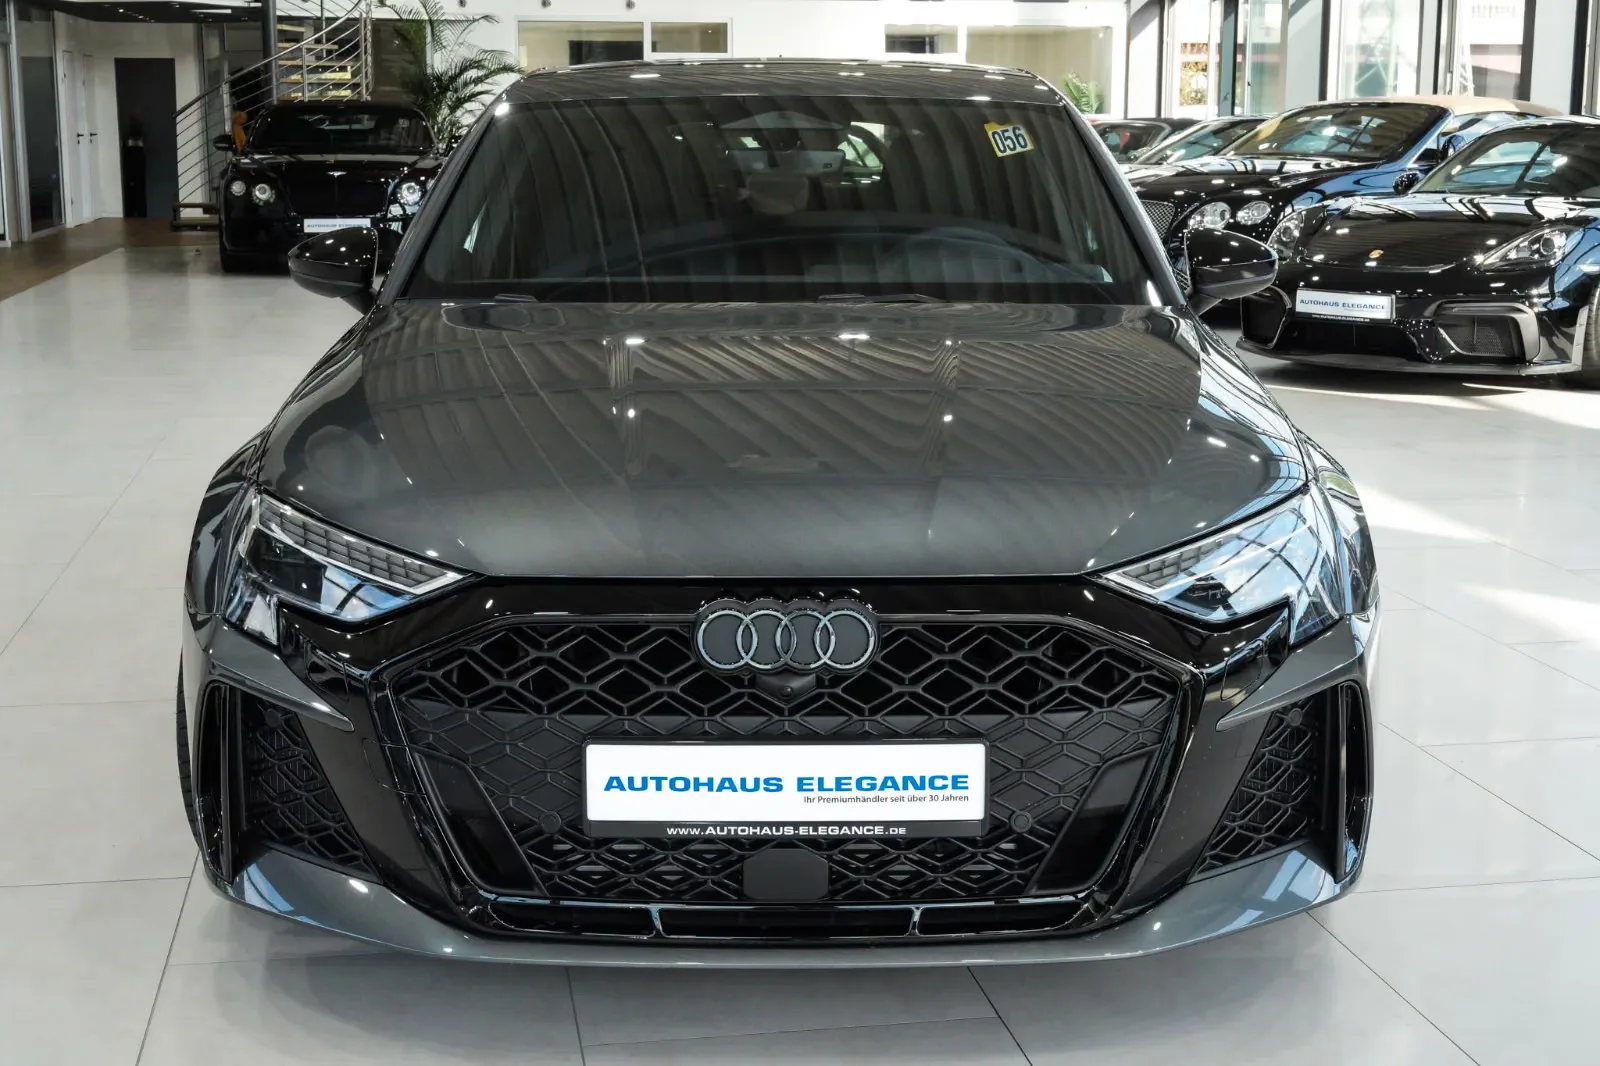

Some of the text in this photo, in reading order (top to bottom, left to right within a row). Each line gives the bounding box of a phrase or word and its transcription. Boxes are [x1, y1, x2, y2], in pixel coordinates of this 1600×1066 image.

[992, 126, 1028, 153] 056
[1299, 299, 1340, 307] AUTOHAUS
[604, 775, 969, 792] AUTOHAUS ELEGANCE
[817, 795, 889, 803] Premiumhändler
[890, 795, 905, 803] seit
[907, 794, 927, 802] über
[940, 794, 969, 802] Jahren
[666, 826, 907, 835] www.AUTOHAUS-ELEGANCE.DE
